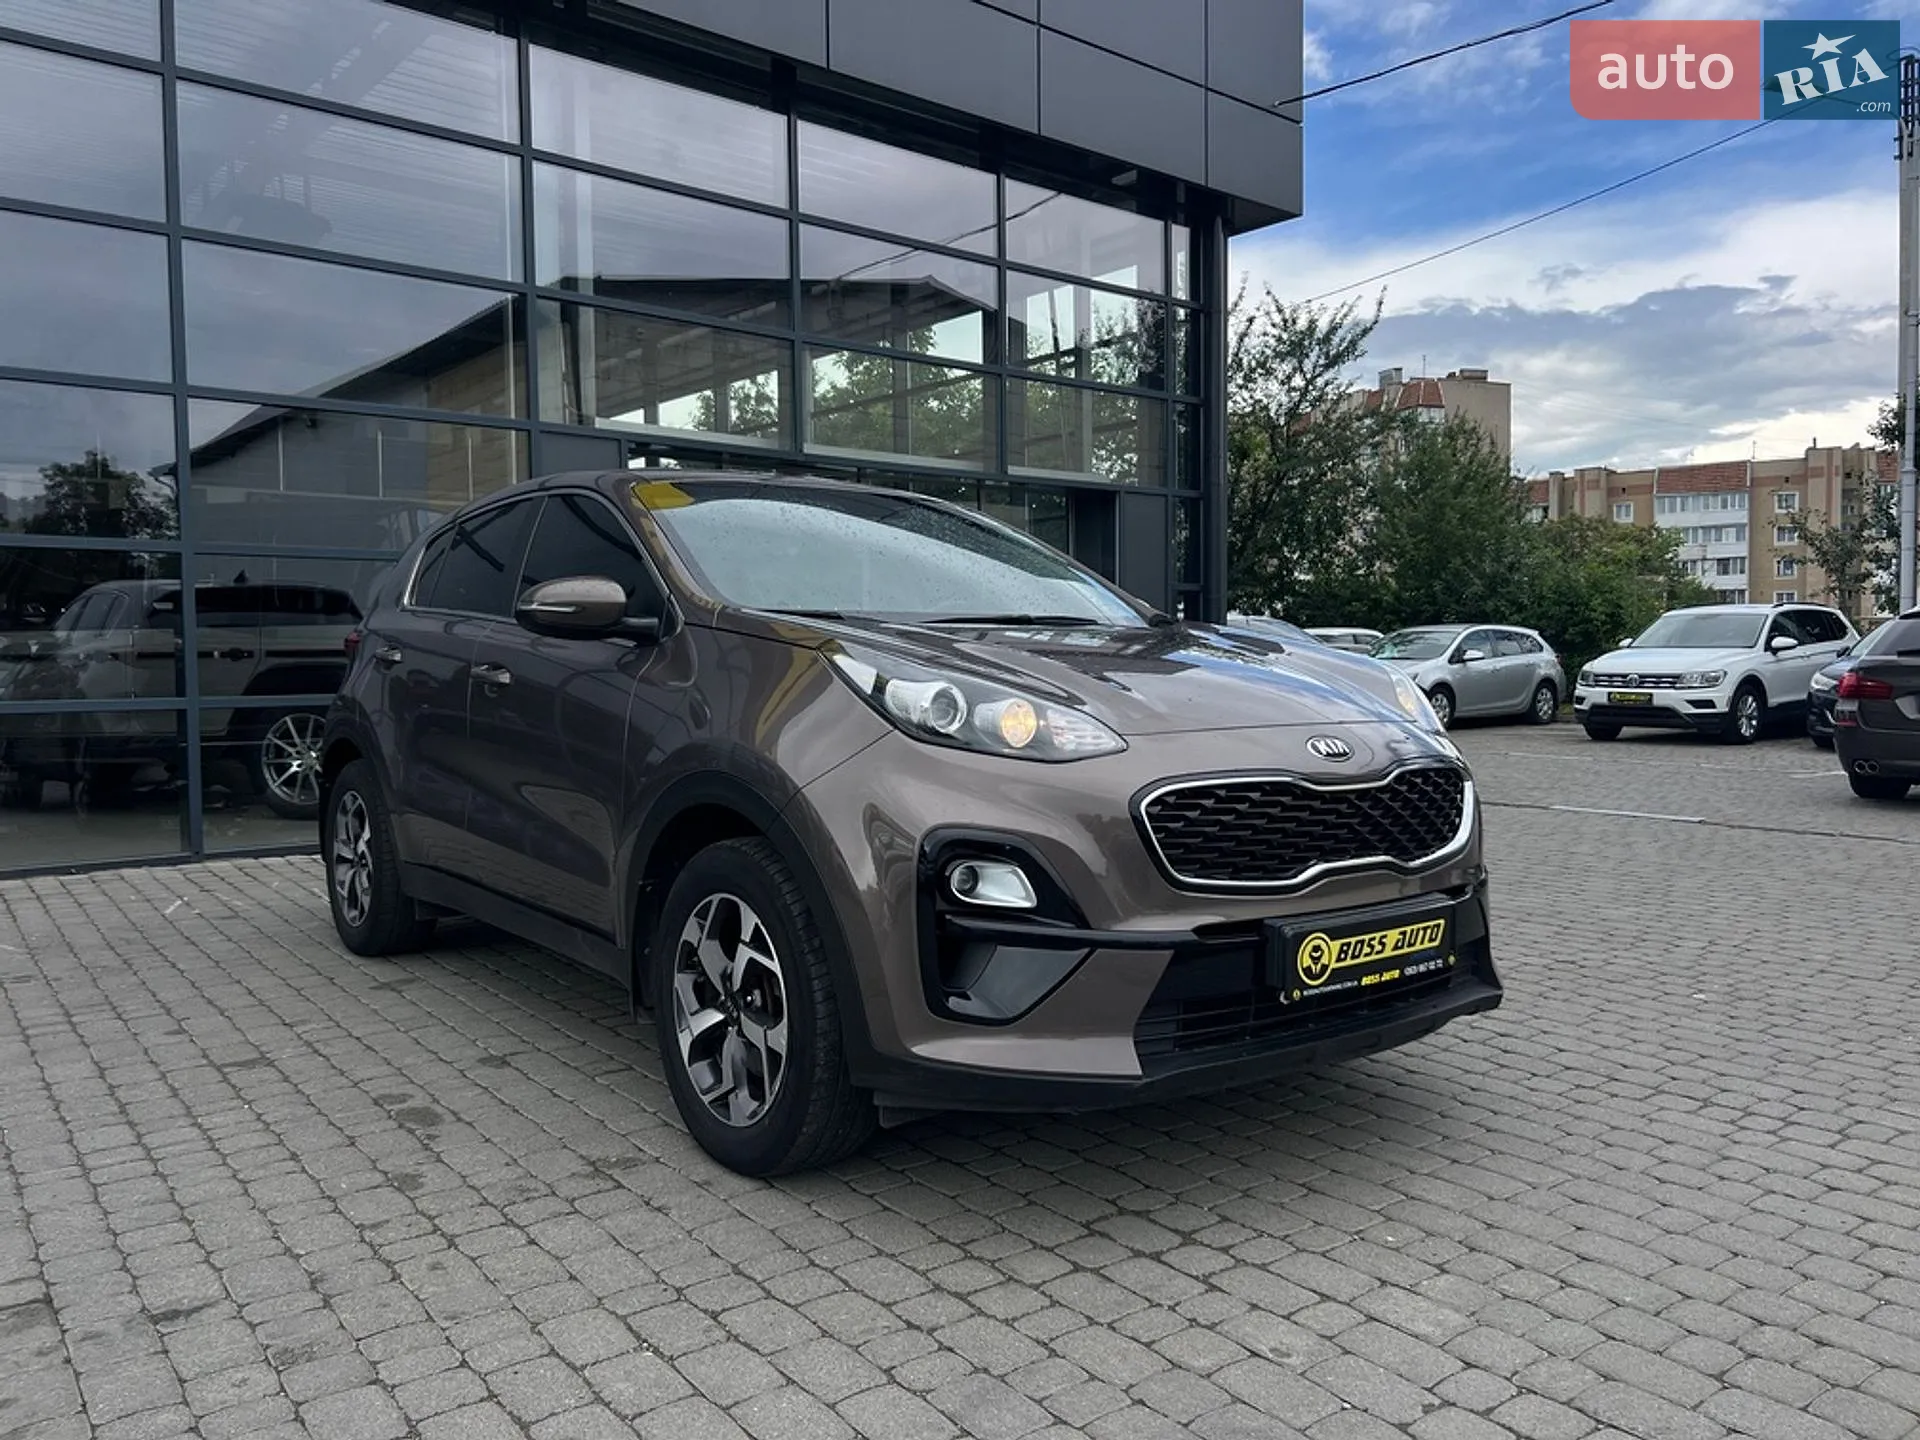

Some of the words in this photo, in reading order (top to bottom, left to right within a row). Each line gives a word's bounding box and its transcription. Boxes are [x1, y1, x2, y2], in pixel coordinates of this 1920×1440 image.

[1309, 738, 1351, 757] KIA
[1335, 933, 1388, 963] BOSS
[1391, 922, 1442, 952] AUTO
[1361, 973, 1381, 987] BOSS
